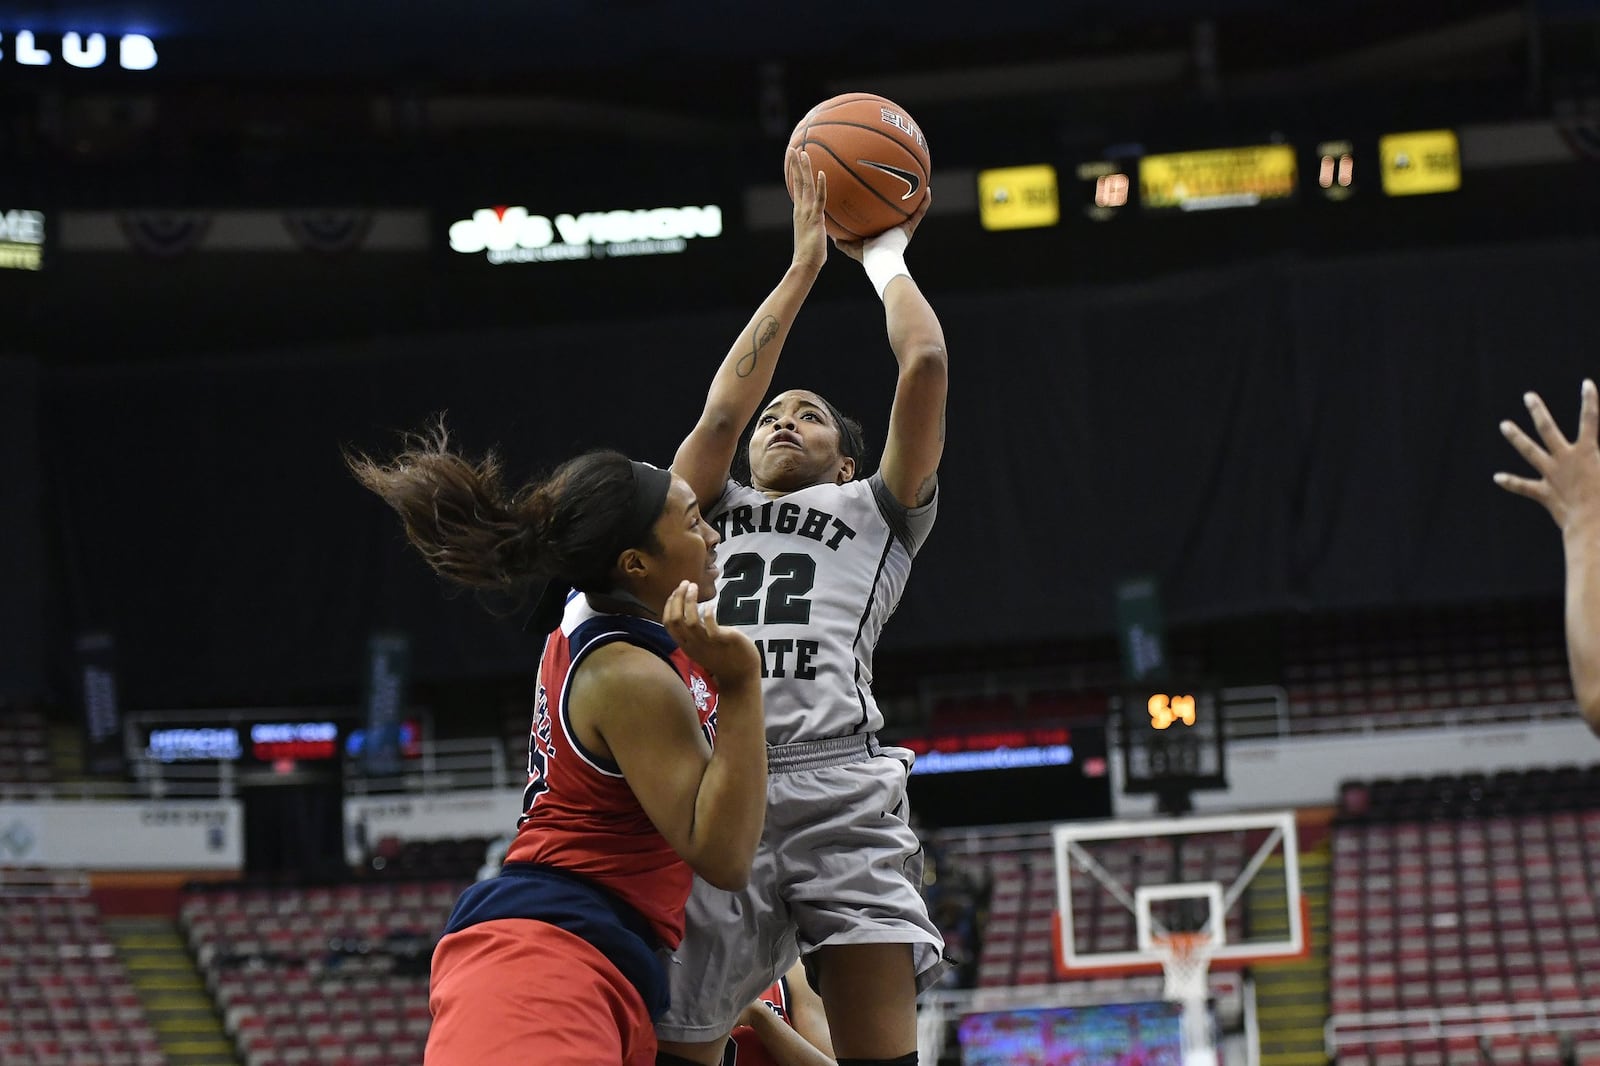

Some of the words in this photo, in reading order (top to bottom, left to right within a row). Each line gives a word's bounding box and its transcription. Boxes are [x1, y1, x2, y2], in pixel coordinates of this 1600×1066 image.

[0, 30, 158, 70] LUB
[1319, 155, 1353, 188] 11
[716, 552, 817, 626] 22
[755, 638, 819, 681] ATE
